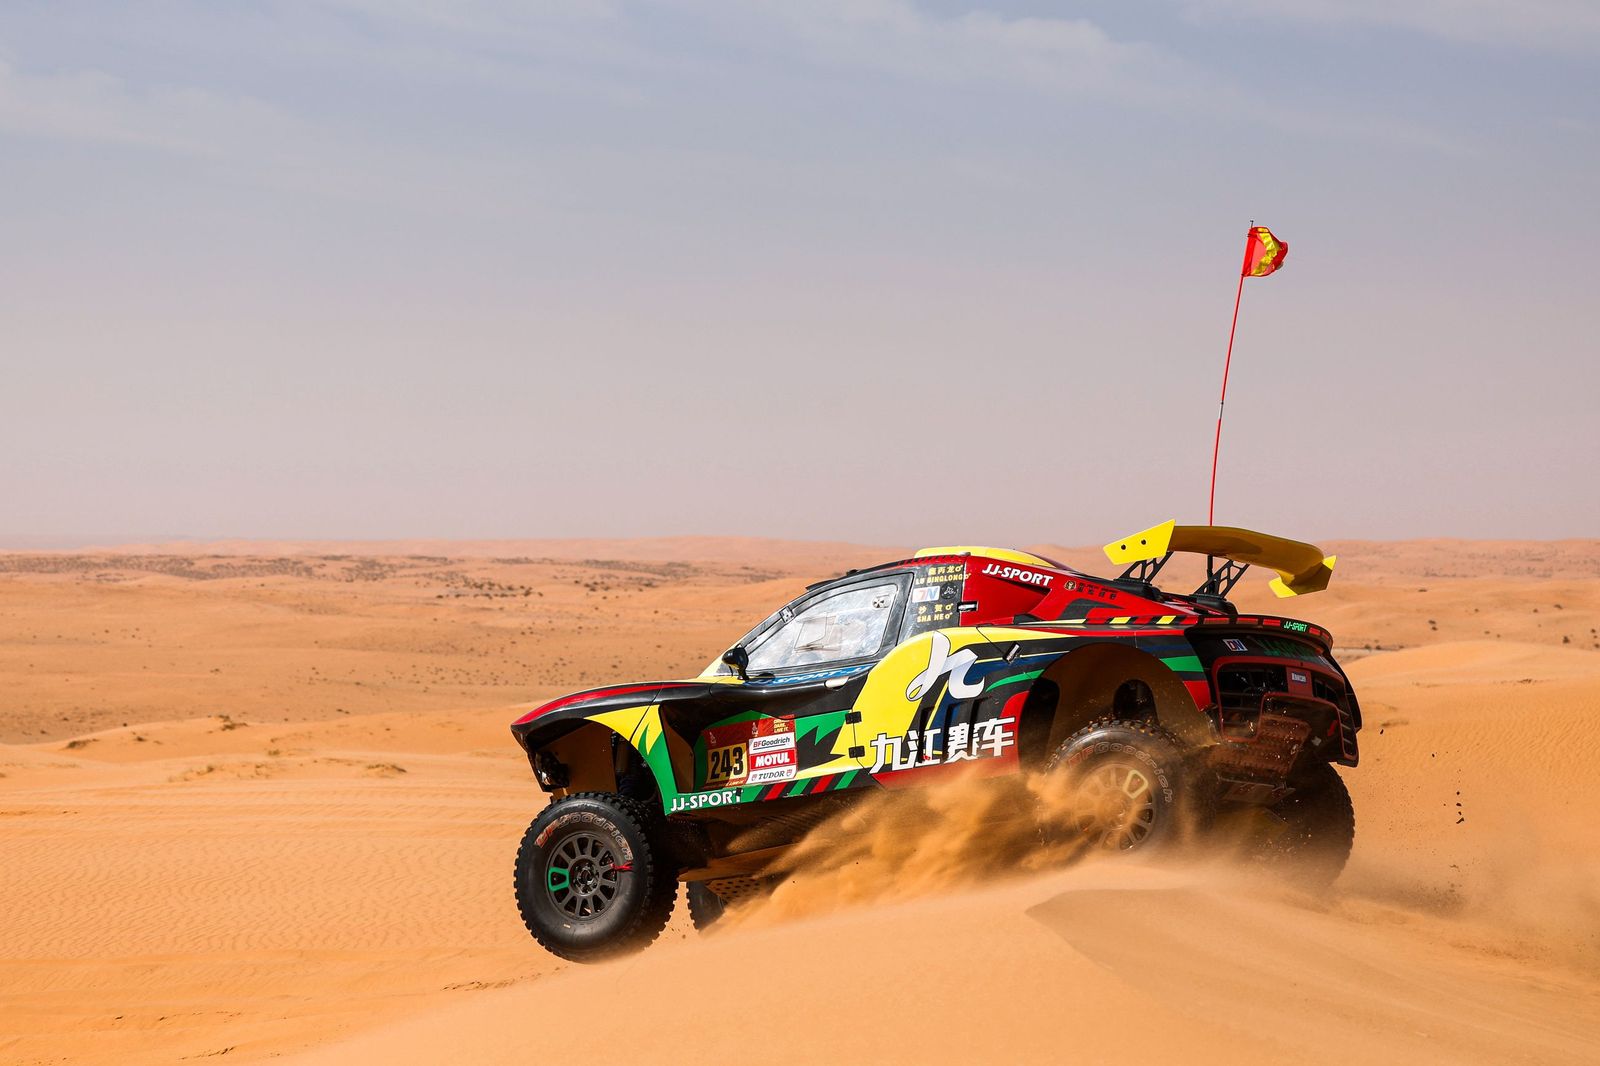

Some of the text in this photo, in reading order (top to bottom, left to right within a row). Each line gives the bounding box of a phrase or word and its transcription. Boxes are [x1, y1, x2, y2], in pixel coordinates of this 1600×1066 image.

[982, 563, 1053, 587] JJ-SPORT
[1284, 620, 1307, 632] JJ-SPORT
[753, 737, 790, 748] BFGoodrich
[869, 716, 1015, 774] 九江赛车
[710, 746, 744, 780] 243
[755, 755, 790, 767] MOTUL
[758, 770, 785, 780] TUDOR
